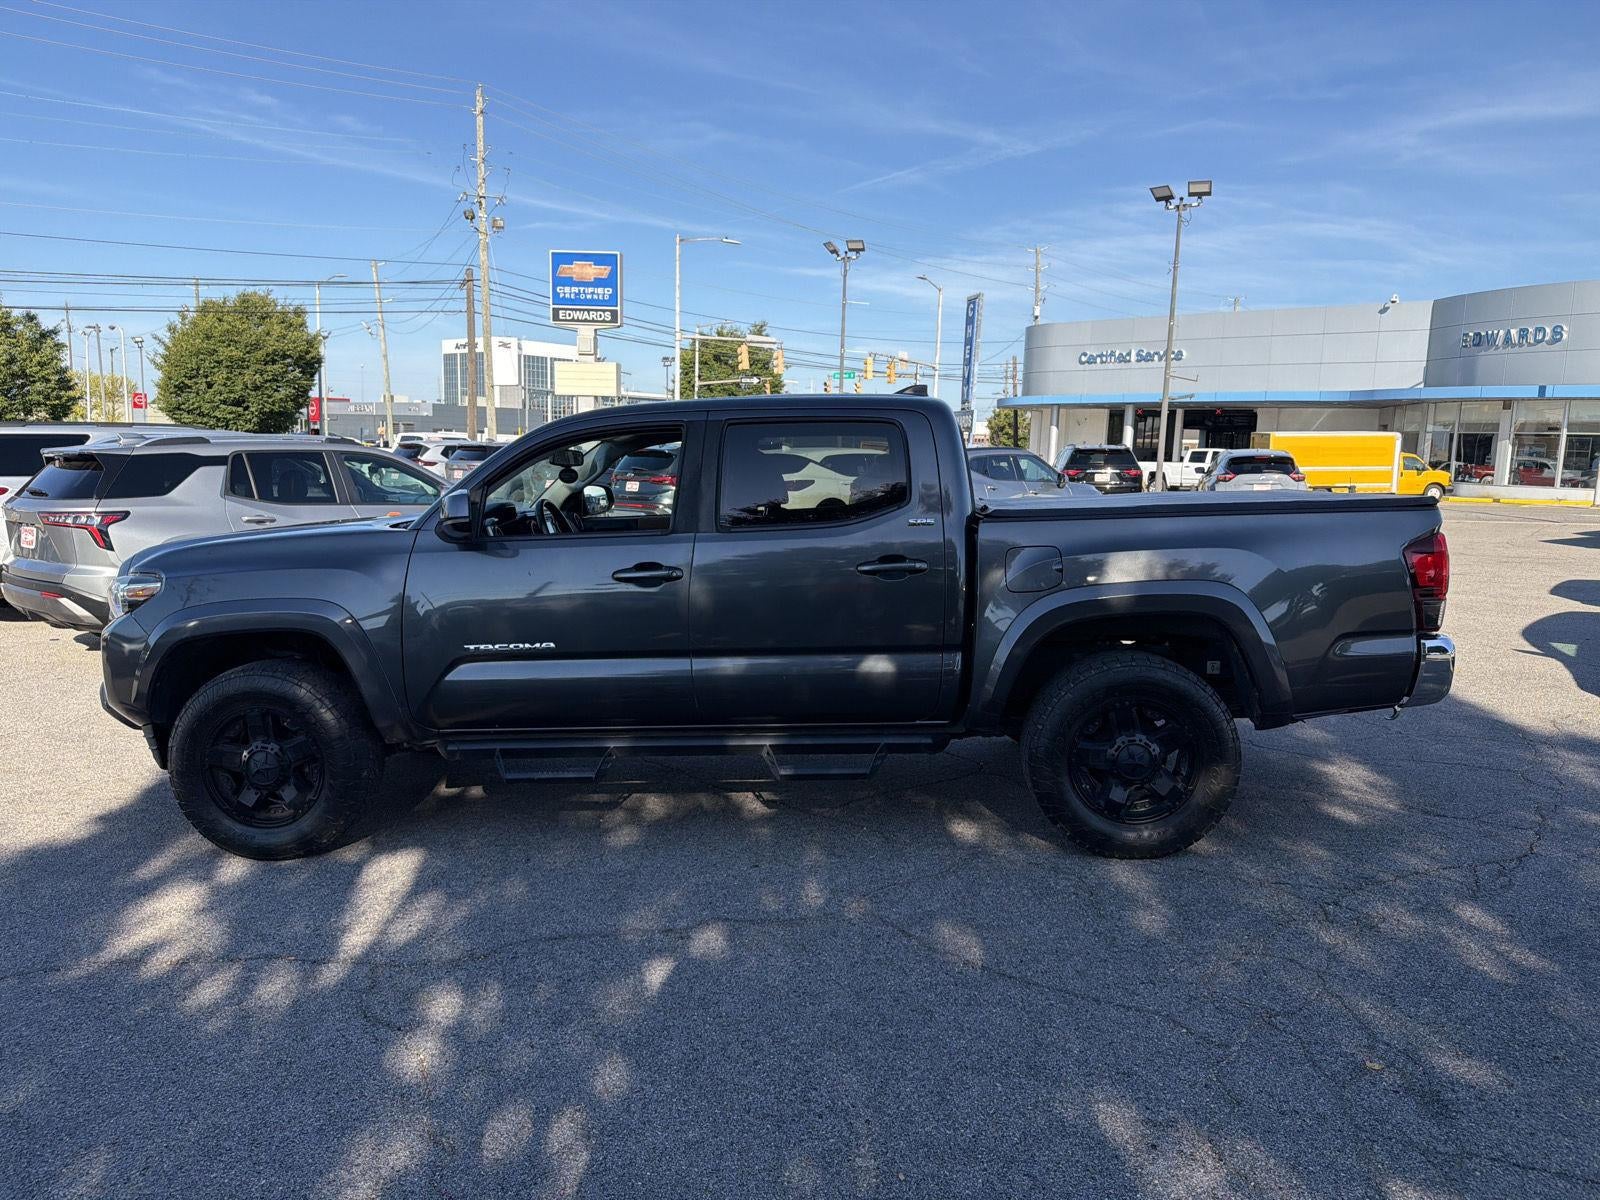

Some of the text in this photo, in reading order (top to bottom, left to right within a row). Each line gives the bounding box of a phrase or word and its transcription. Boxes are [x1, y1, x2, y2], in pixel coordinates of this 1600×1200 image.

[556, 286, 612, 295] CERTIFIED
[559, 310, 612, 321] EDWARDS
[1462, 325, 1566, 348] EDWARDS
[963, 303, 974, 400] CHEVY
[1079, 348, 1184, 365] Certified Servce
[463, 642, 556, 651] TACOMA
